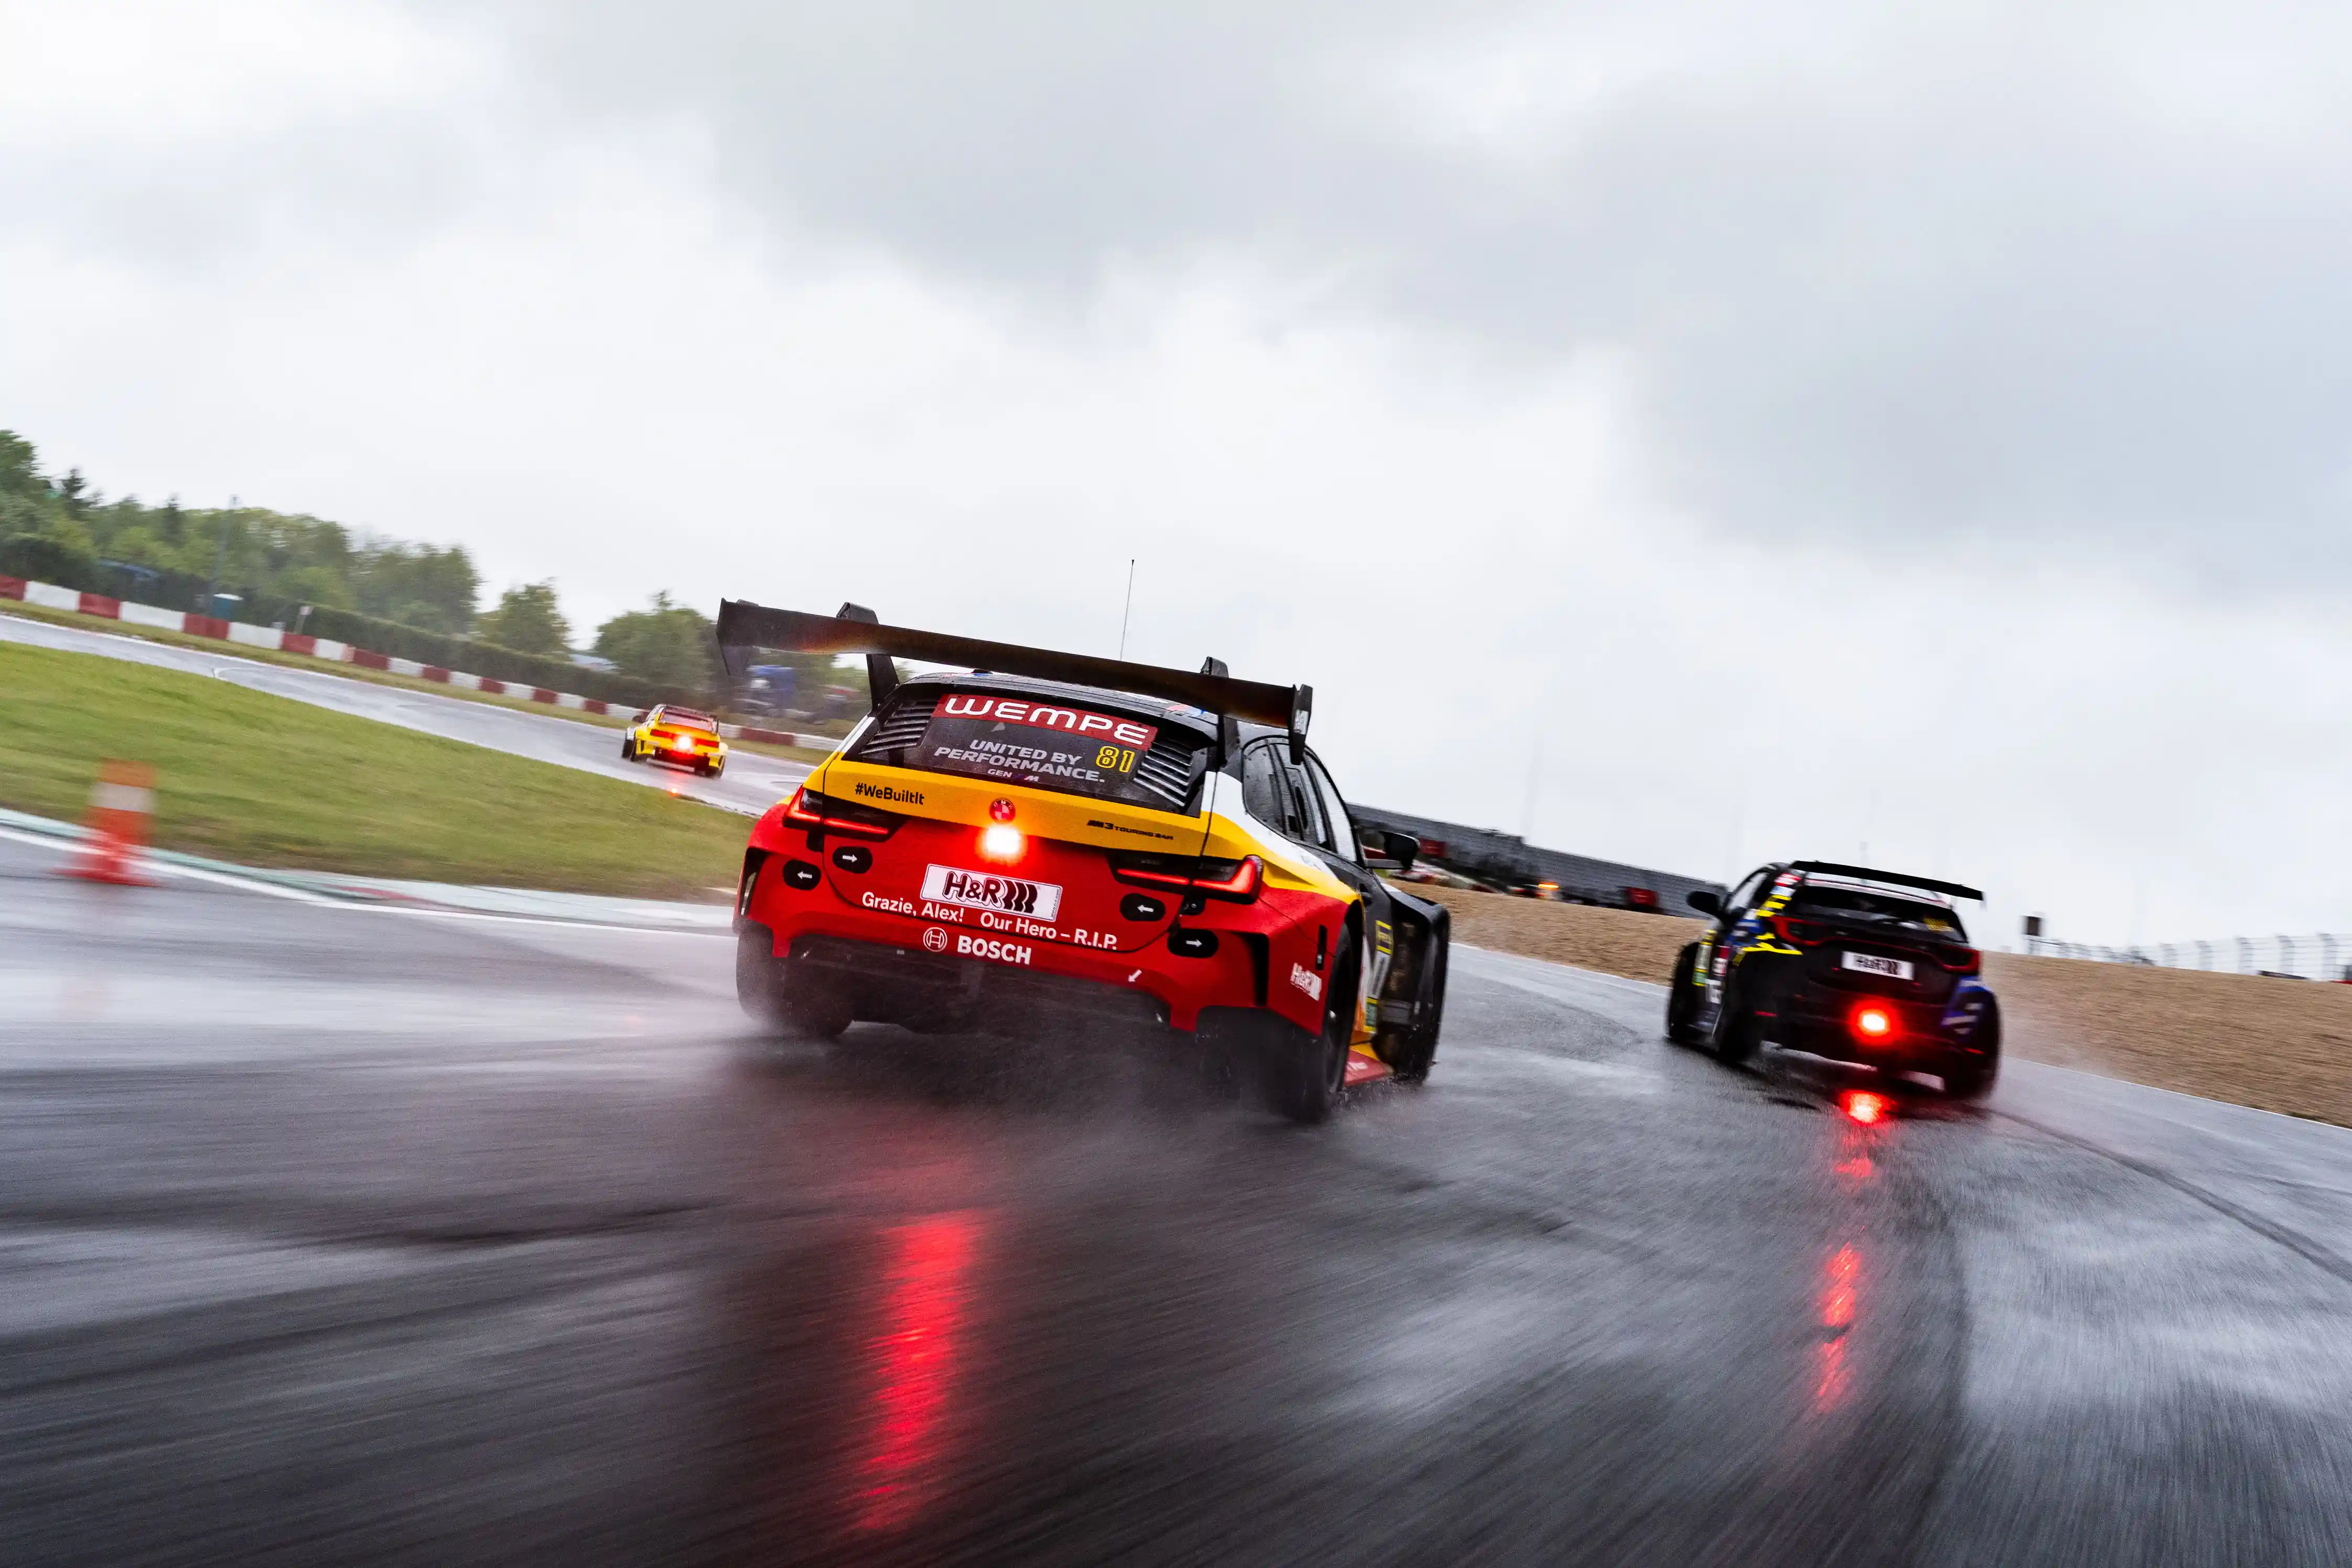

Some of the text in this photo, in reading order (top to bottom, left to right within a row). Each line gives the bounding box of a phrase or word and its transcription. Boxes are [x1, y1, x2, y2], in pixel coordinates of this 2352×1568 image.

[944, 698, 1149, 745] WEMPE
[934, 747, 1105, 782] PERFORMANCE.
[970, 739, 1083, 765] UNITED BY
[1096, 746, 1135, 773] 81
[987, 769, 1013, 778] GEN
[855, 782, 925, 805] #WeBuiltIt
[1114, 826, 1153, 837] TOURING
[942, 871, 1006, 908] H&R
[862, 891, 917, 917] Grazie,
[921, 901, 965, 922] Alex!
[980, 911, 1012, 931] Our
[1015, 918, 1057, 939] Hero
[1074, 928, 1117, 951] R.I.P.
[957, 935, 1032, 965] BOSCH
